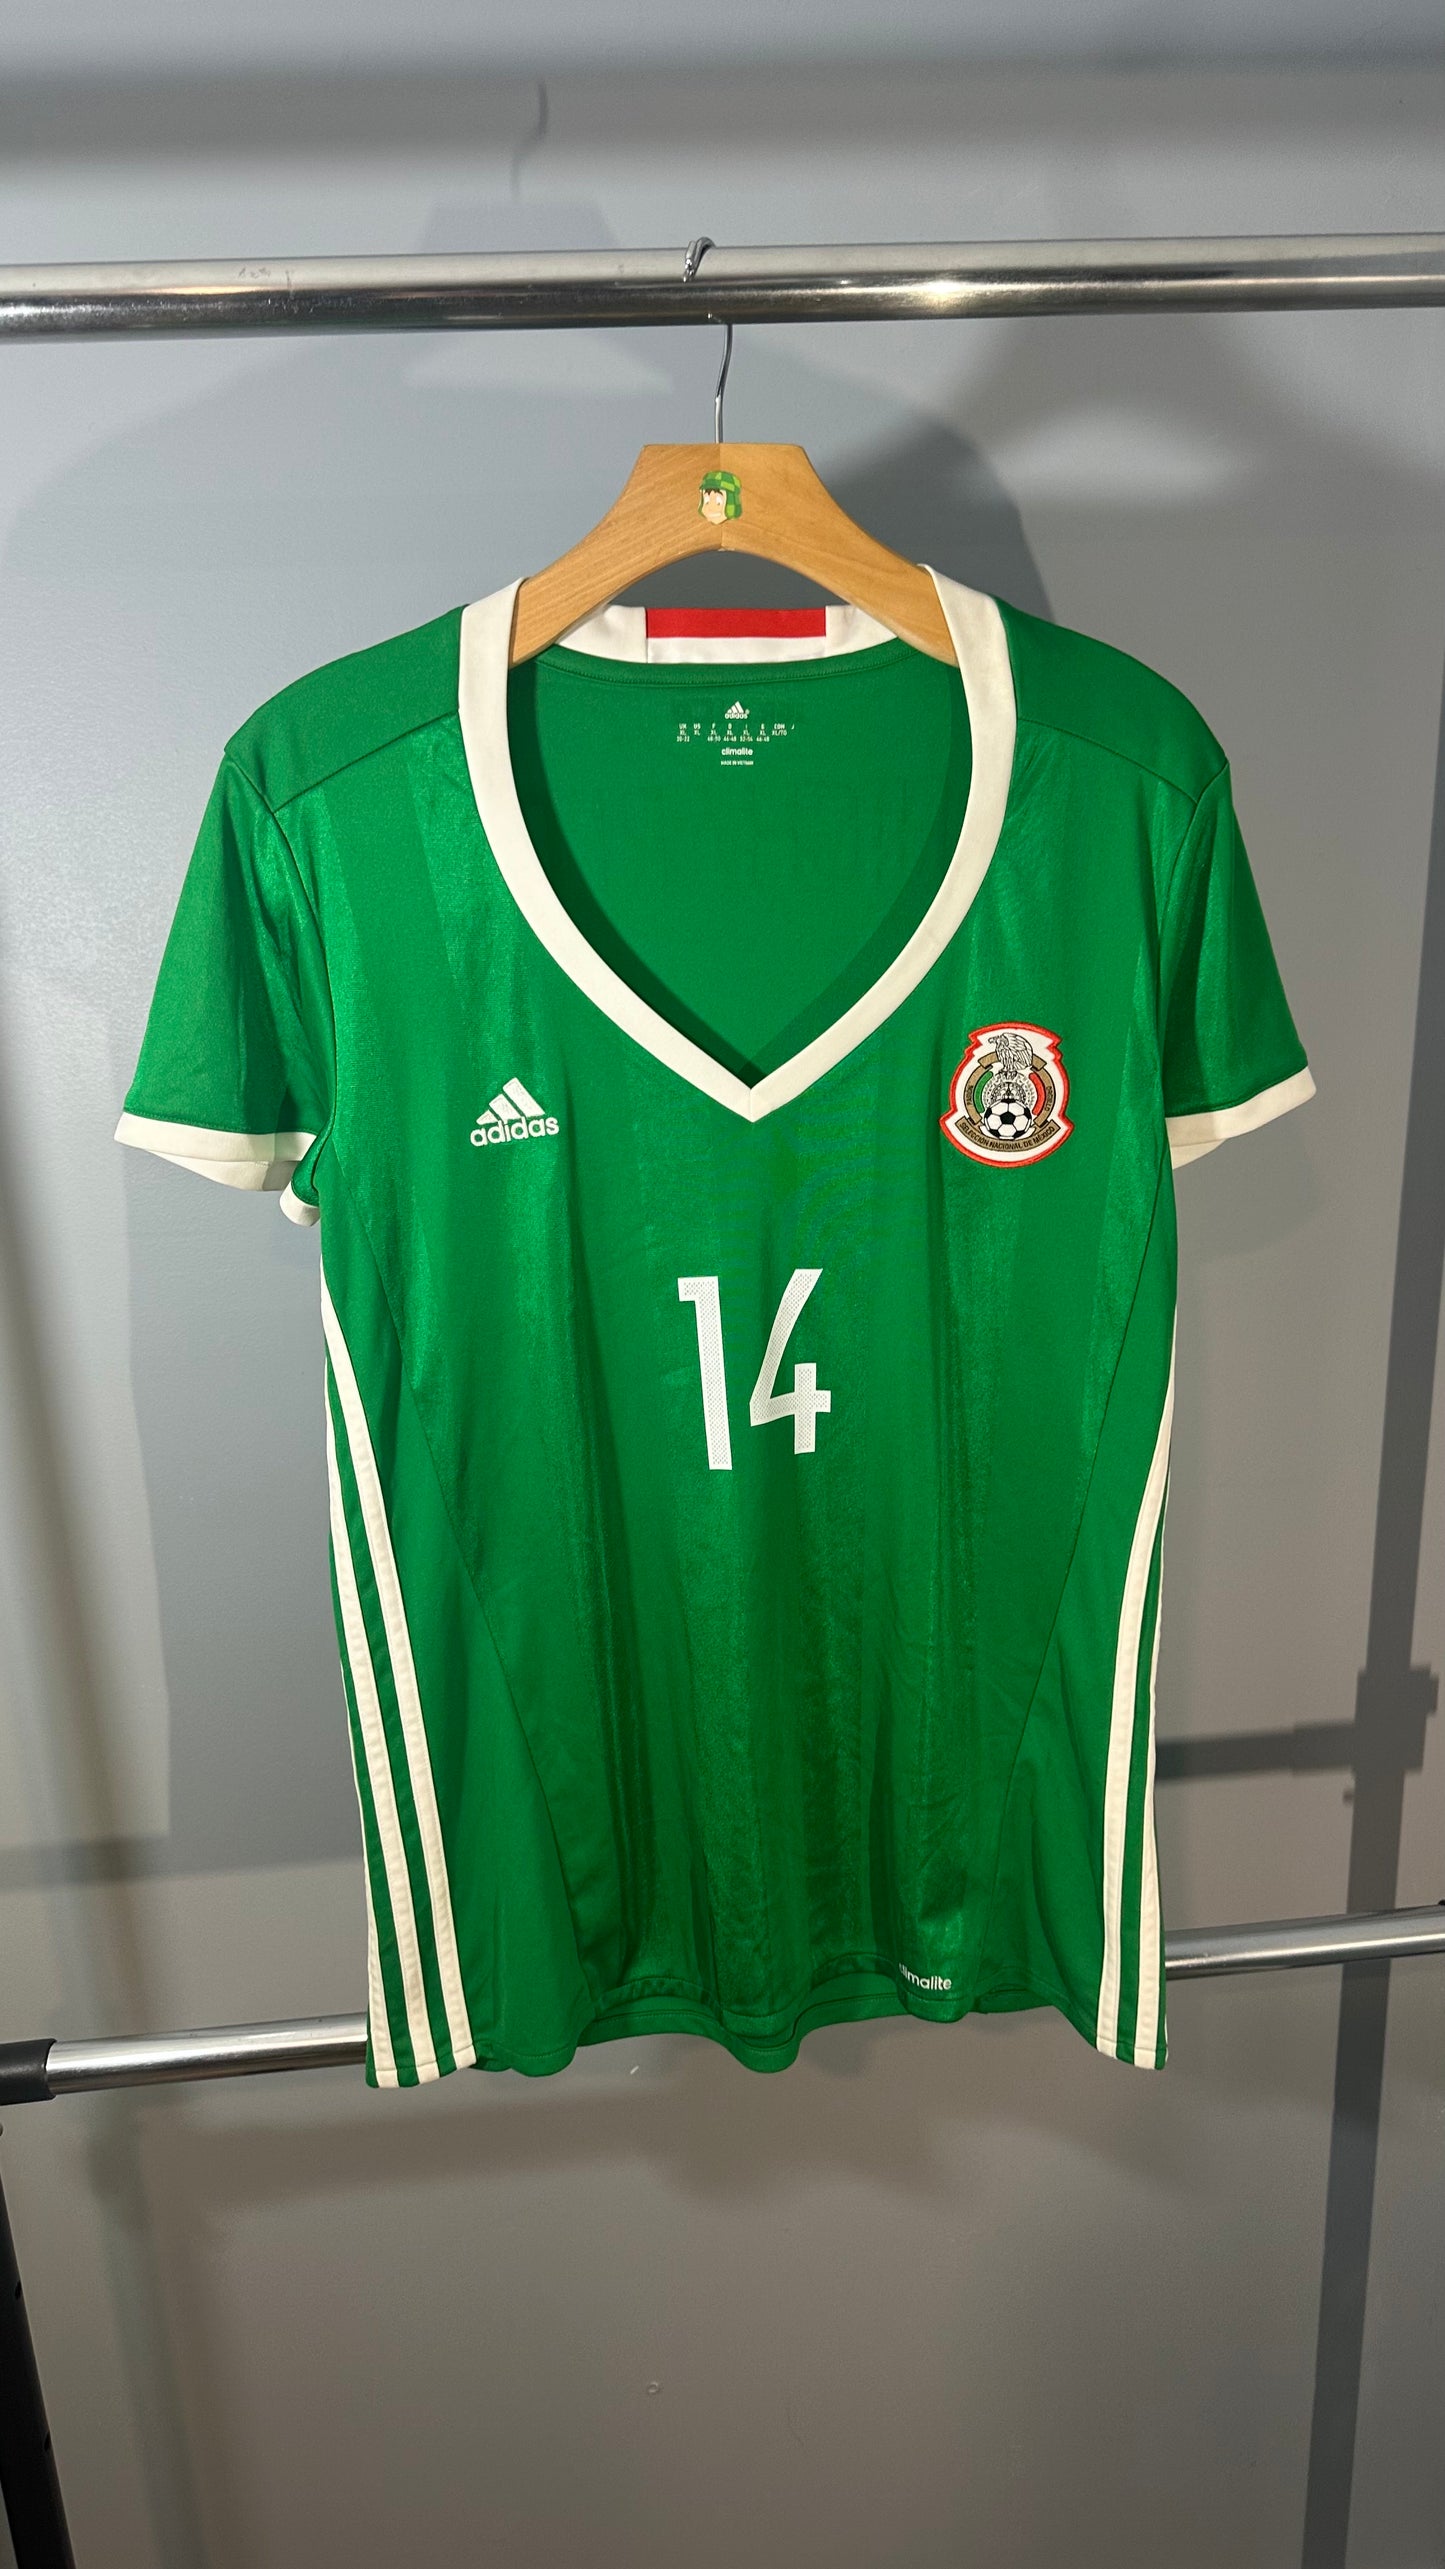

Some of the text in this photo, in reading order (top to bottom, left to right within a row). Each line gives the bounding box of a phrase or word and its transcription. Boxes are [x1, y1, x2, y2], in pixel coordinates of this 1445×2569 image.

[724, 712, 748, 720] adidas
[721, 746, 754, 756] climalite
[470, 1117, 560, 1147] adidas
[989, 1140, 1023, 1151] NACIONAL
[1023, 1139, 1034, 1149] DE
[677, 1268, 832, 1471] 14
